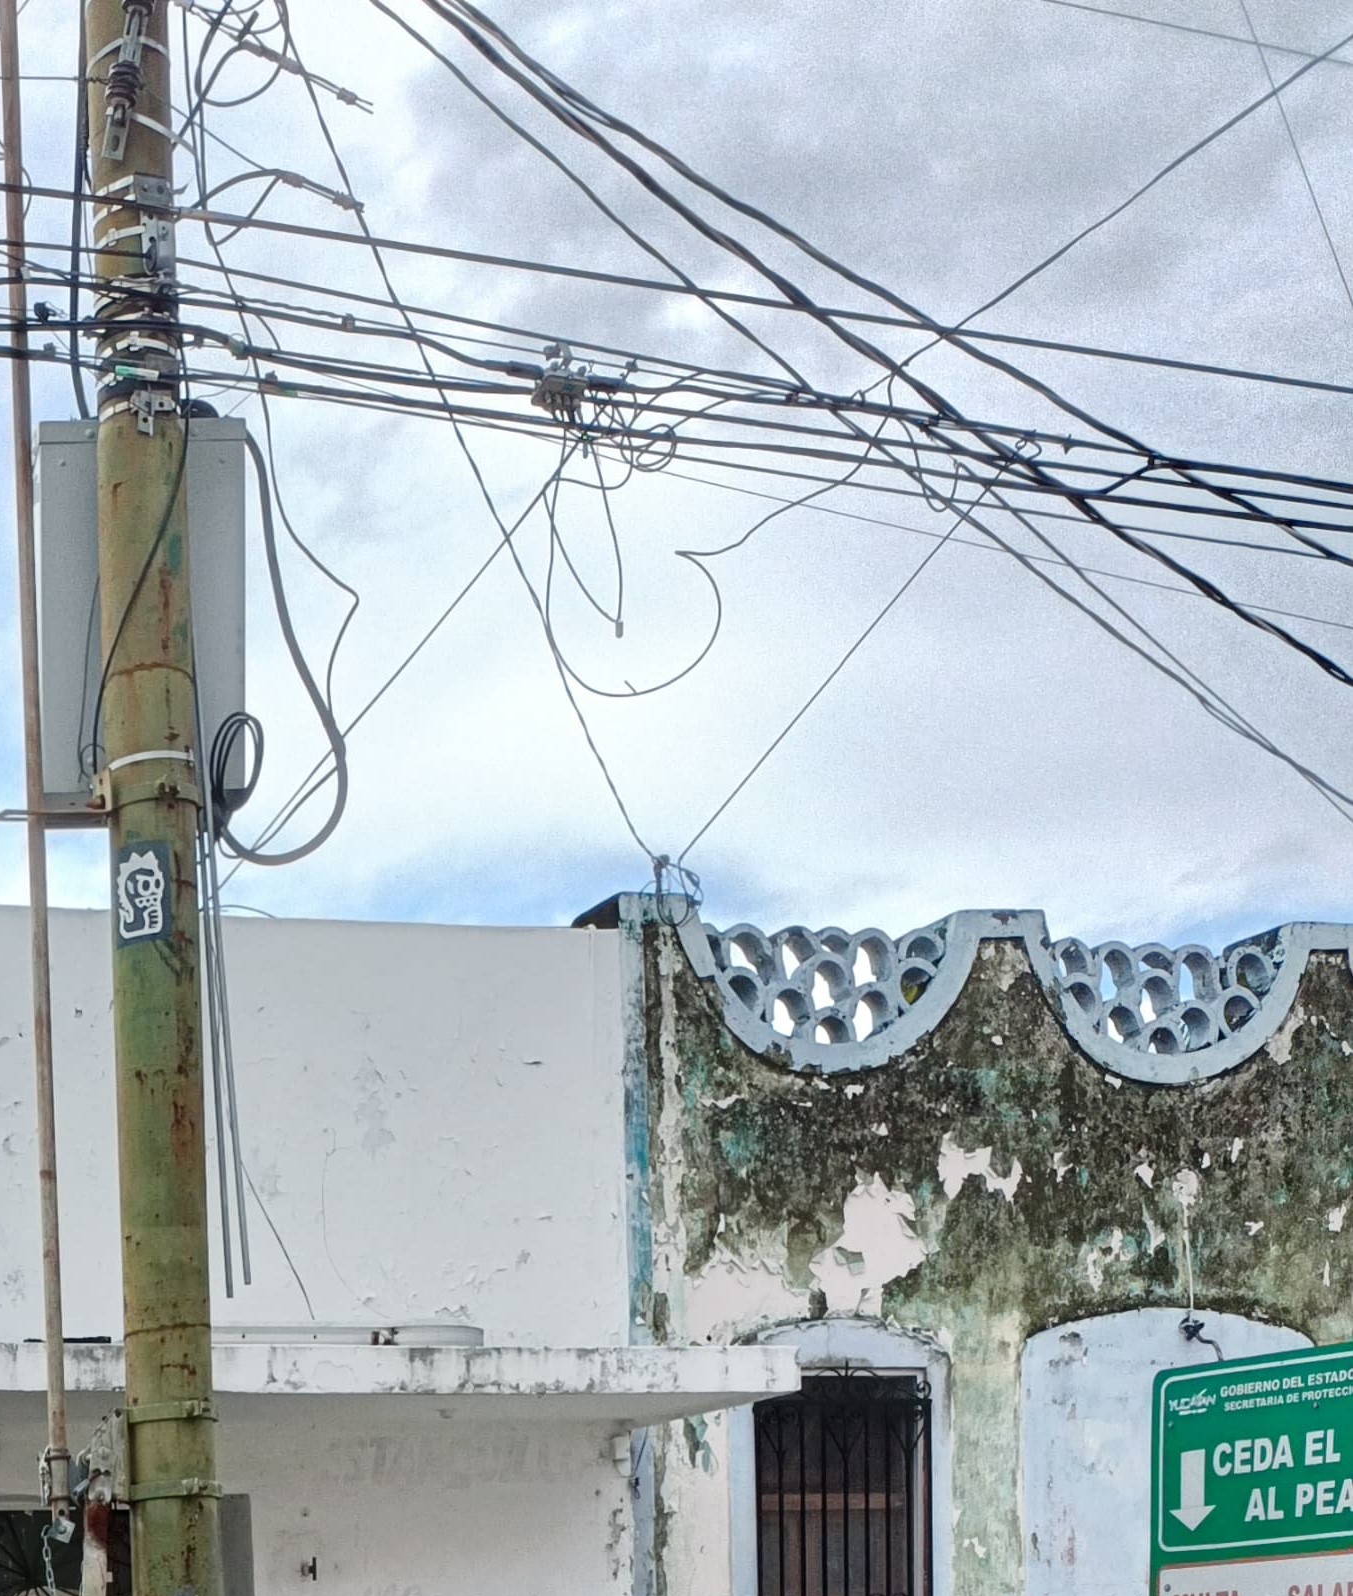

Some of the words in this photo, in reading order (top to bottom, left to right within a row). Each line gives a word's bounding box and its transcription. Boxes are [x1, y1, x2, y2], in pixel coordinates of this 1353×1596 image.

[1220, 1379, 1281, 1398] GOBIERNO
[1282, 1375, 1305, 1390] DEL
[1223, 1394, 1284, 1412] SECRETARIA
[1286, 1392, 1299, 1404] DE
[1301, 1385, 1353, 1402] PROTECCI
[1212, 1434, 1295, 1477] CEDA
[1304, 1428, 1341, 1466] EL
[1244, 1486, 1285, 1522] AL
